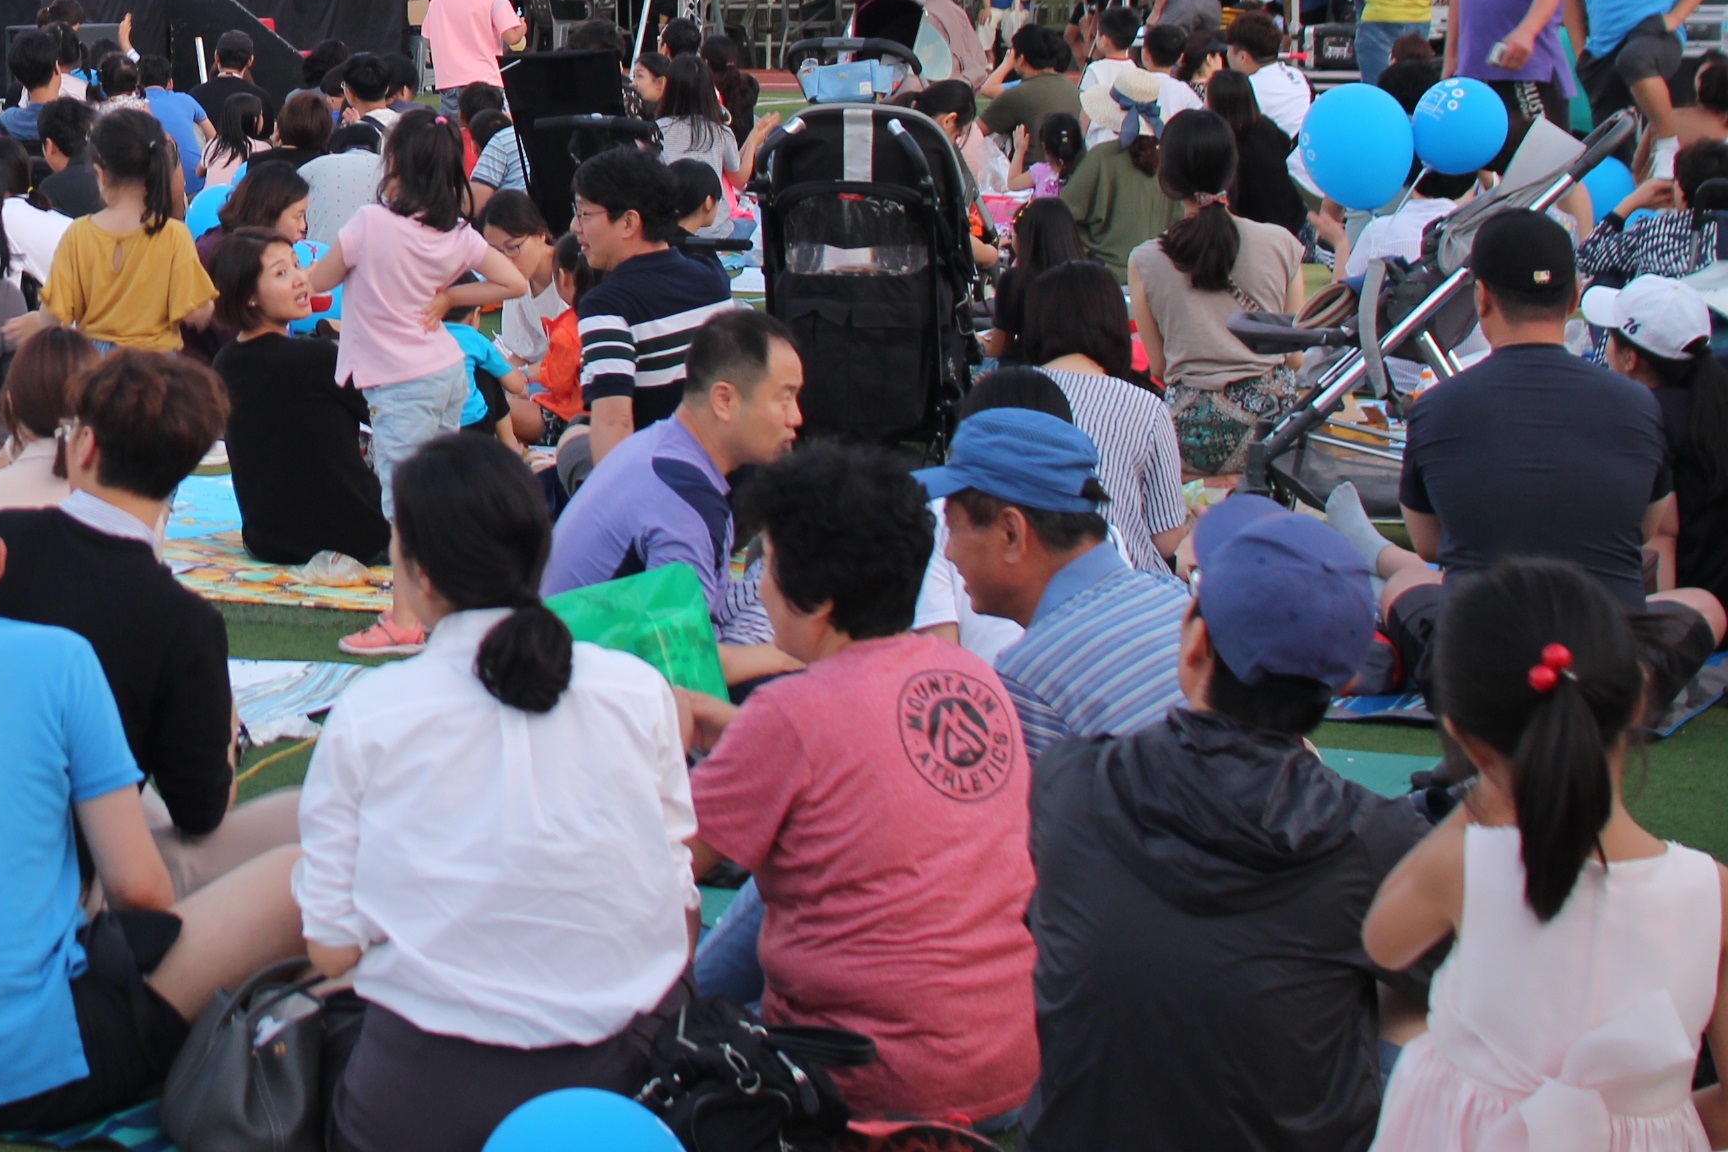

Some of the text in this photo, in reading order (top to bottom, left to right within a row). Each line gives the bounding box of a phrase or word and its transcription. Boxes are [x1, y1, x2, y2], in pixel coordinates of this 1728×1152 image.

[1622, 317, 1642, 335] 76
[905, 674, 997, 734] MOUNTAIN
[916, 731, 1009, 794] ATHLETICS
